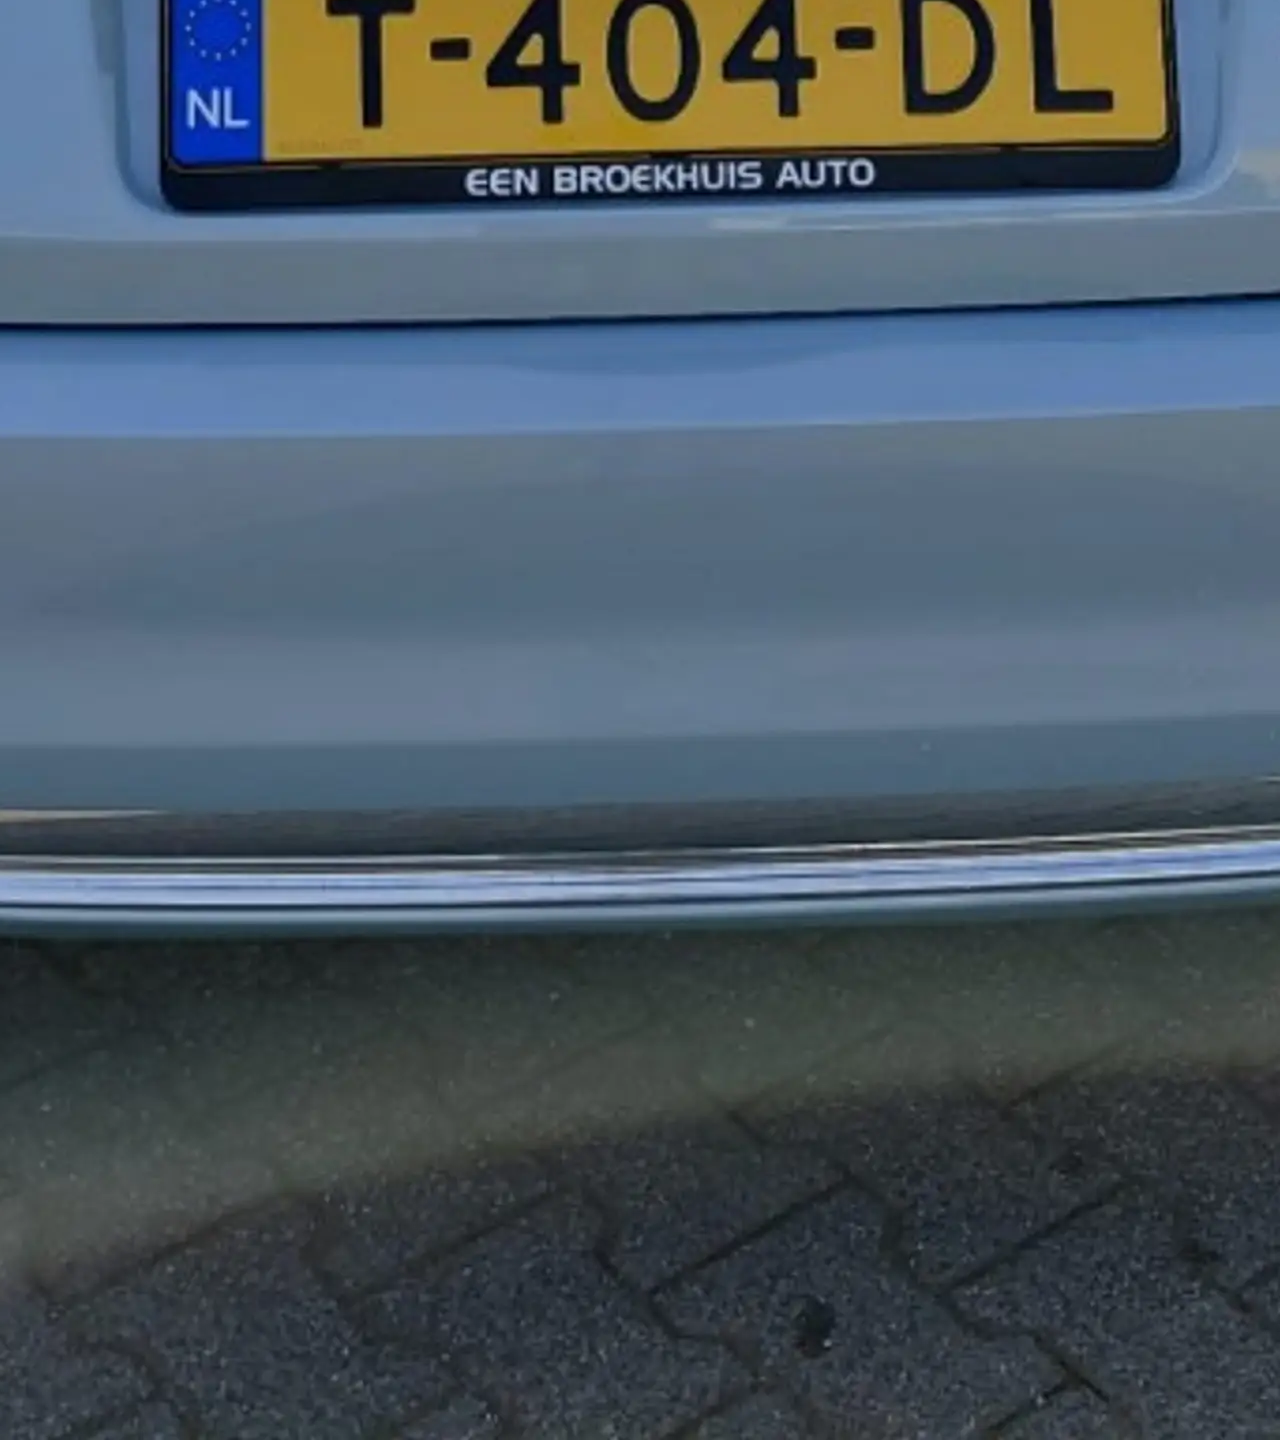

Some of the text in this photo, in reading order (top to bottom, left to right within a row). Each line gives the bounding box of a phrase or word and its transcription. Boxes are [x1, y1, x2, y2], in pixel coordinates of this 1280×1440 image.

[186, 88, 250, 131] NL
[464, 158, 877, 197] EEN BROEKHUIS AUTO
